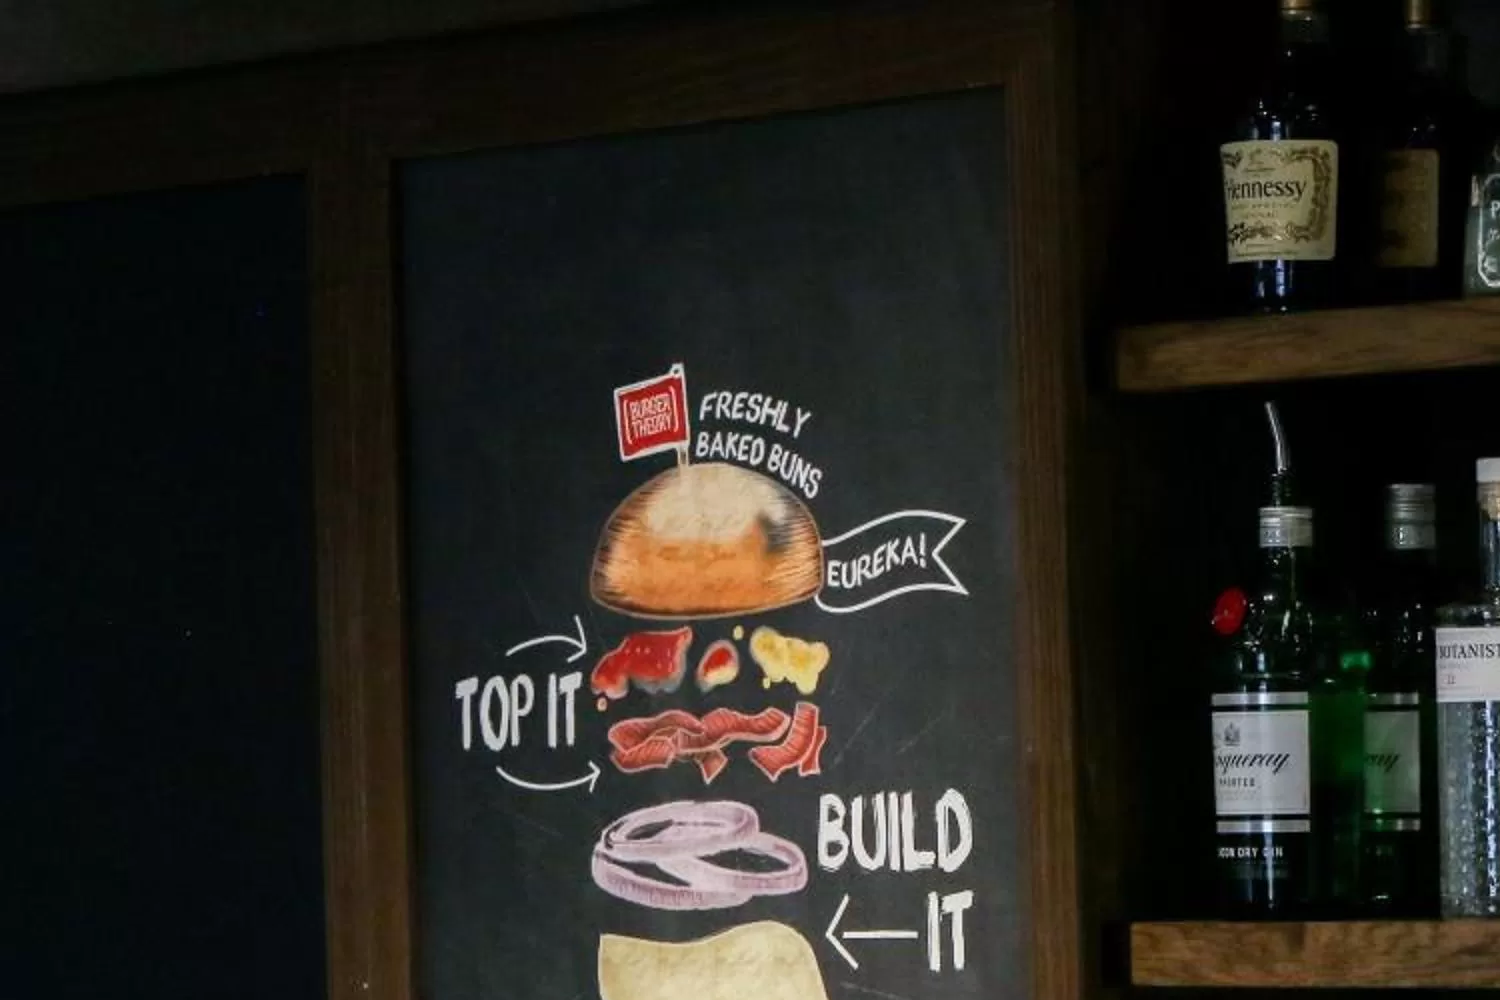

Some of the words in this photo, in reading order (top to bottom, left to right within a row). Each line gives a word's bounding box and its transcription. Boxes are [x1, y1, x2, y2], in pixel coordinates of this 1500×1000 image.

[629, 394, 671, 419] BURGER
[632, 413, 673, 438] THEORY
[699, 391, 811, 438] FRESHLY
[696, 431, 765, 465] BAKED
[767, 444, 823, 498] BUNS
[827, 533, 927, 589] EUREKA!
[455, 674, 535, 752] TOP
[547, 672, 583, 747] IT
[817, 788, 974, 873] BUILD
[927, 890, 974, 972] IT
